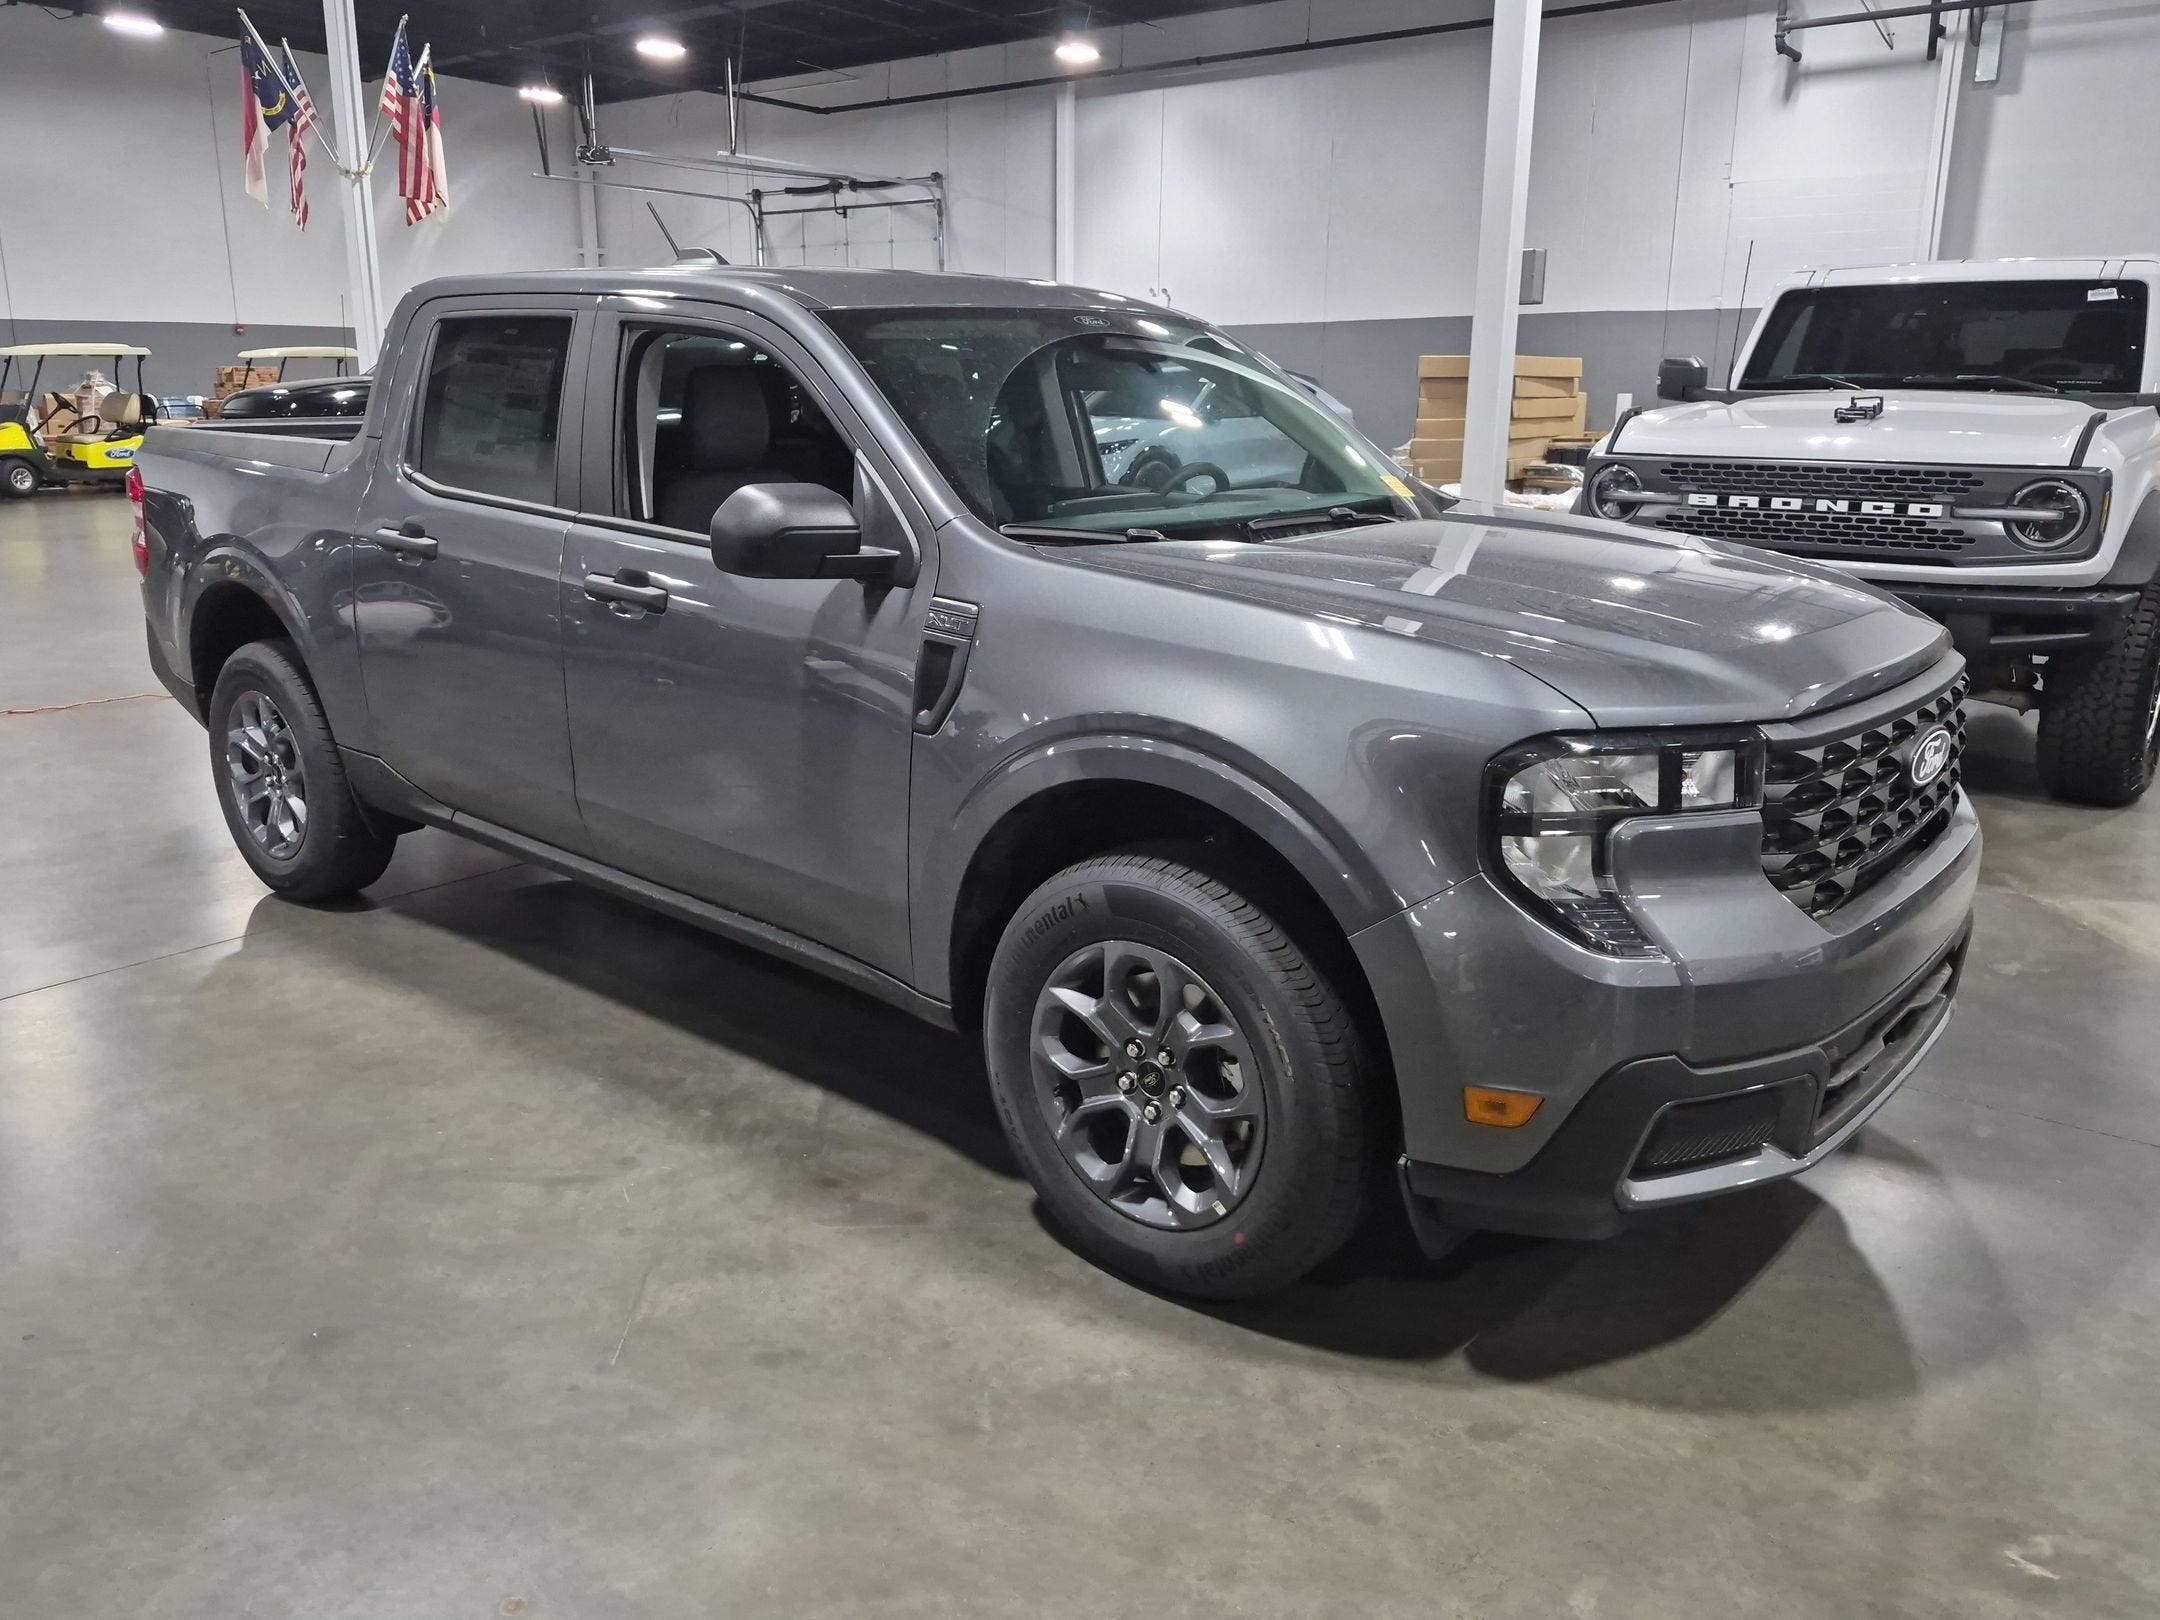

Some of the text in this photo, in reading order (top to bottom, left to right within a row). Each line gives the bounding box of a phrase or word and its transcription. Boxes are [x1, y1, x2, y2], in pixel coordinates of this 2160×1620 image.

[1688, 493, 1943, 518] BRONCO
[928, 612, 970, 631] XLT
[1919, 737, 1947, 778] Ford
